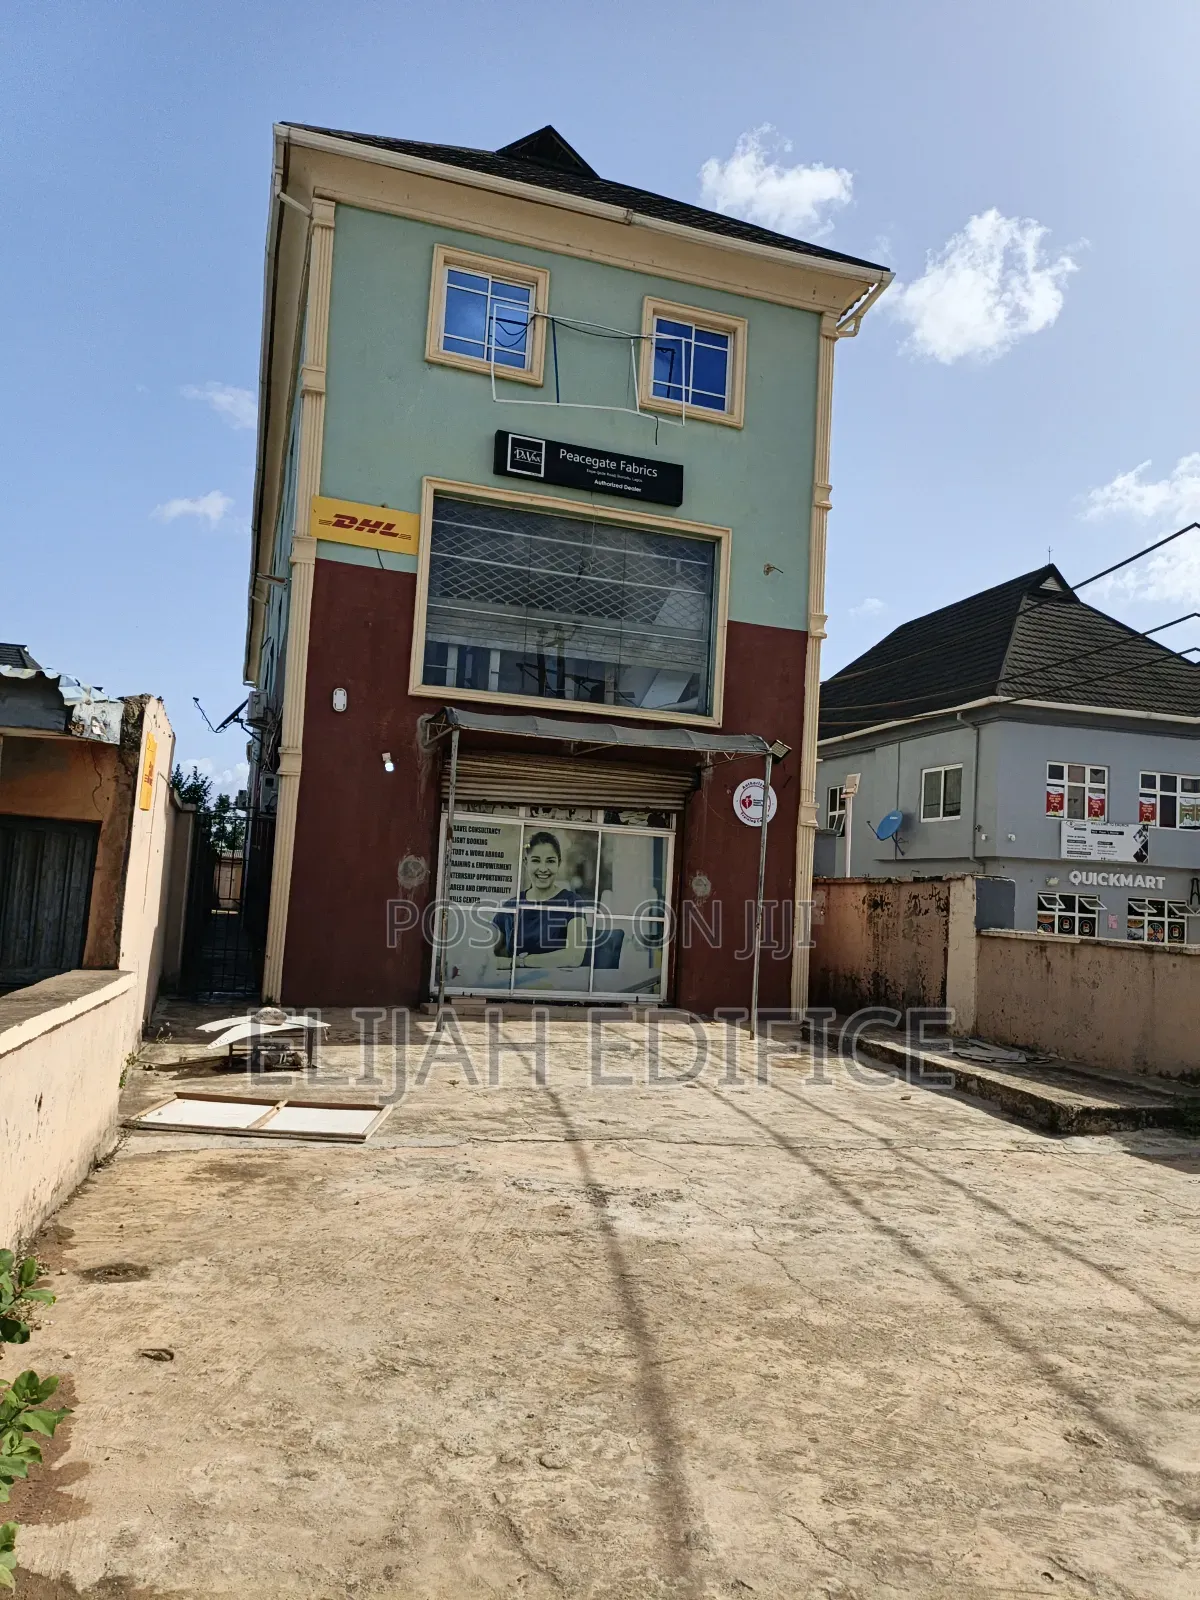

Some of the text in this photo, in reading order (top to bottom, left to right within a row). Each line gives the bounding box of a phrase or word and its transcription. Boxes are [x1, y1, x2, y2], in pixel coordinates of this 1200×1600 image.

[559, 448, 658, 478] Peacegate Fabrics
[594, 479, 642, 493] Authorized Dealer
[331, 513, 400, 538] DHL
[468, 826, 501, 835] CONSULTANCY
[466, 838, 488, 846] BOOKING
[469, 850, 485, 858] WORK
[485, 851, 505, 859] ABROAD
[475, 862, 512, 871] EMPOWERMENT
[450, 872, 513, 883] NTERNSHIP OPPORTUNITIES
[1068, 870, 1166, 890] QUICKMART
[476, 885, 512, 894] EMPLOYABILITY
